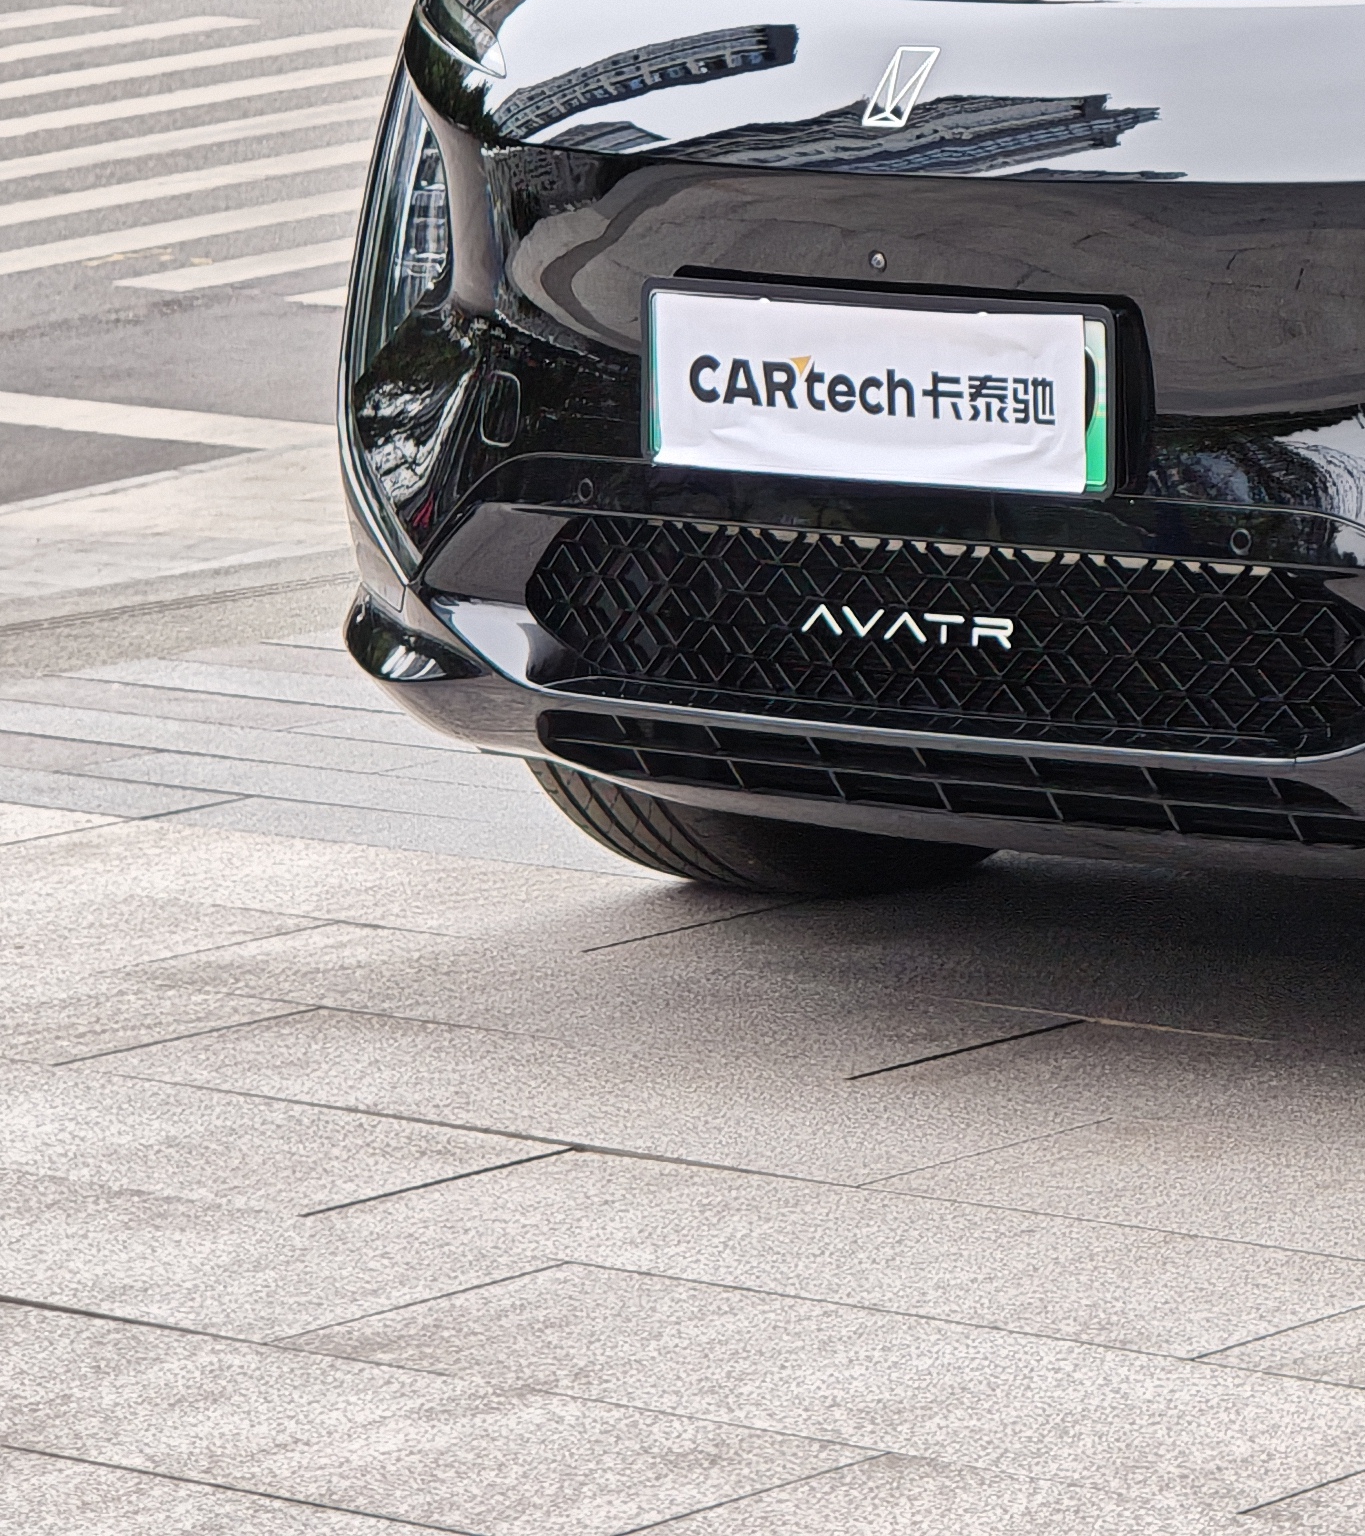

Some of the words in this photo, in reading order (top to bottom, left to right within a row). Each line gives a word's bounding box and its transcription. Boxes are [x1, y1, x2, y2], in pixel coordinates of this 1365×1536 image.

[922, 370, 1057, 427] 卡泰驰
[801, 603, 1014, 650] AVATR
